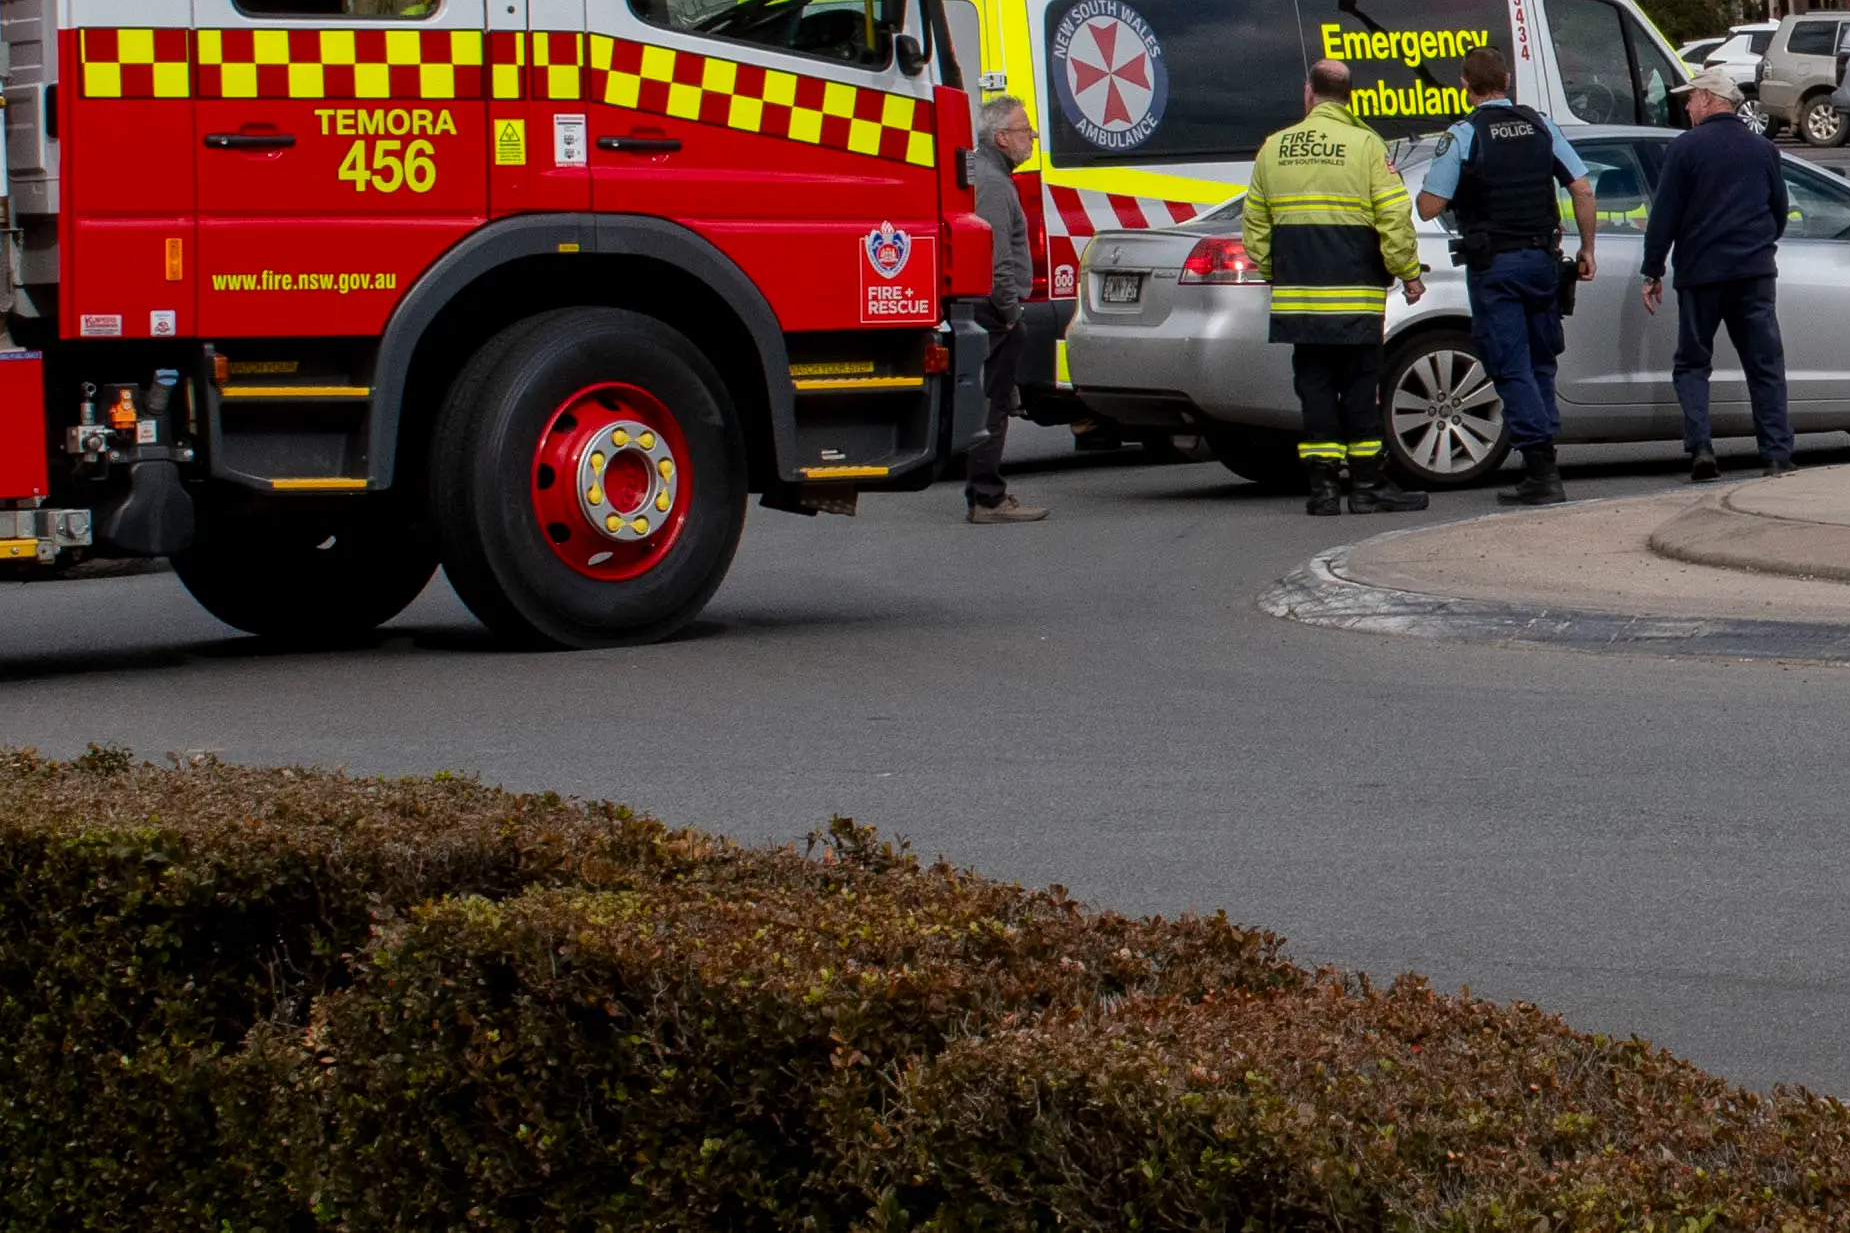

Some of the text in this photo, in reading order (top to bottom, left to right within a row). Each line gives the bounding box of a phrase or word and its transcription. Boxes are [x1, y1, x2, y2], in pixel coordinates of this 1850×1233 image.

[1054, 0, 1161, 59] NEW SOUTH WALES
[1320, 23, 1489, 68] Emergency
[314, 108, 457, 136] TEMORA
[1076, 112, 1158, 148] AMBULANCE
[1490, 124, 1536, 139] POLICE
[1281, 130, 1317, 144] FIRE
[1279, 143, 1346, 158] RESCUE
[337, 138, 437, 193] 456
[212, 269, 397, 294] www.fire.nsw.gov.au
[1055, 274, 1074, 288] 000
[867, 286, 903, 300] FIRE
[867, 300, 929, 315] RESCUE
